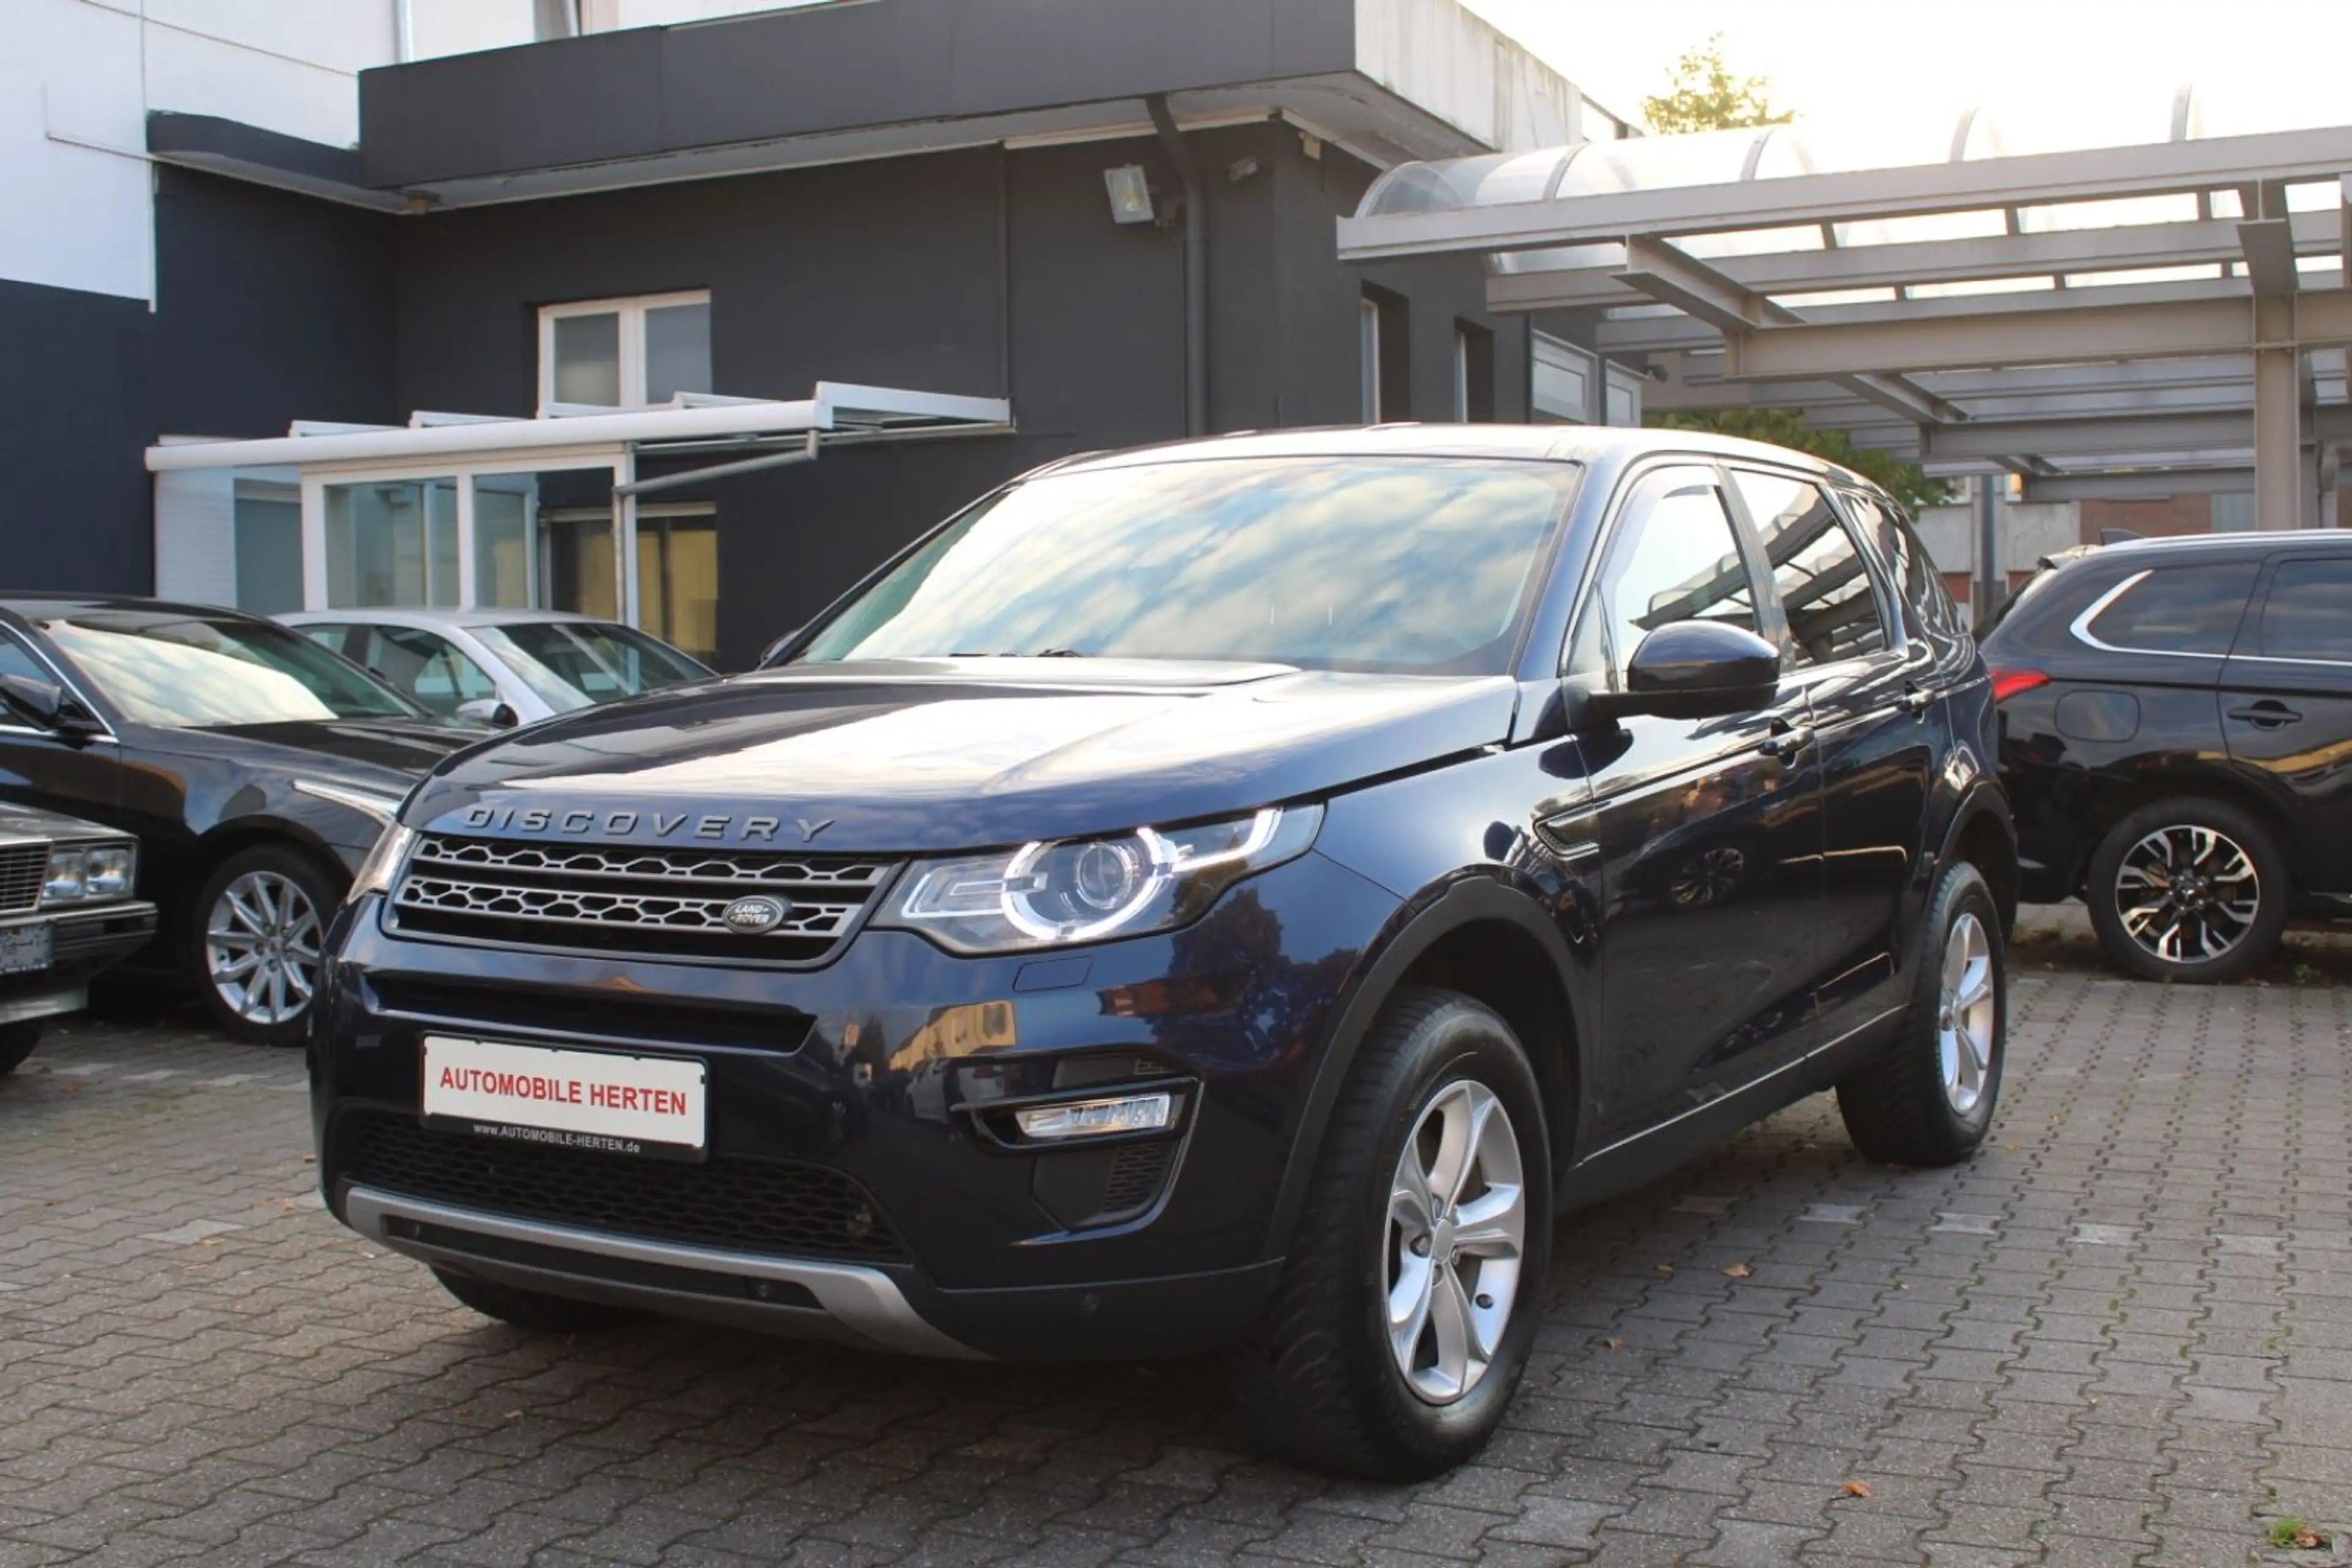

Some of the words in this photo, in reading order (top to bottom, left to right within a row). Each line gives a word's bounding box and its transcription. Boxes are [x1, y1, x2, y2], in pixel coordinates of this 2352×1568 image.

[463, 807, 835, 842] DISCOVERY
[440, 1066, 582, 1104] AUTOMOBILE
[590, 1083, 686, 1116] HERTEN
[473, 1123, 641, 1153] www.AUTOMOBILE-HERTEN.de
